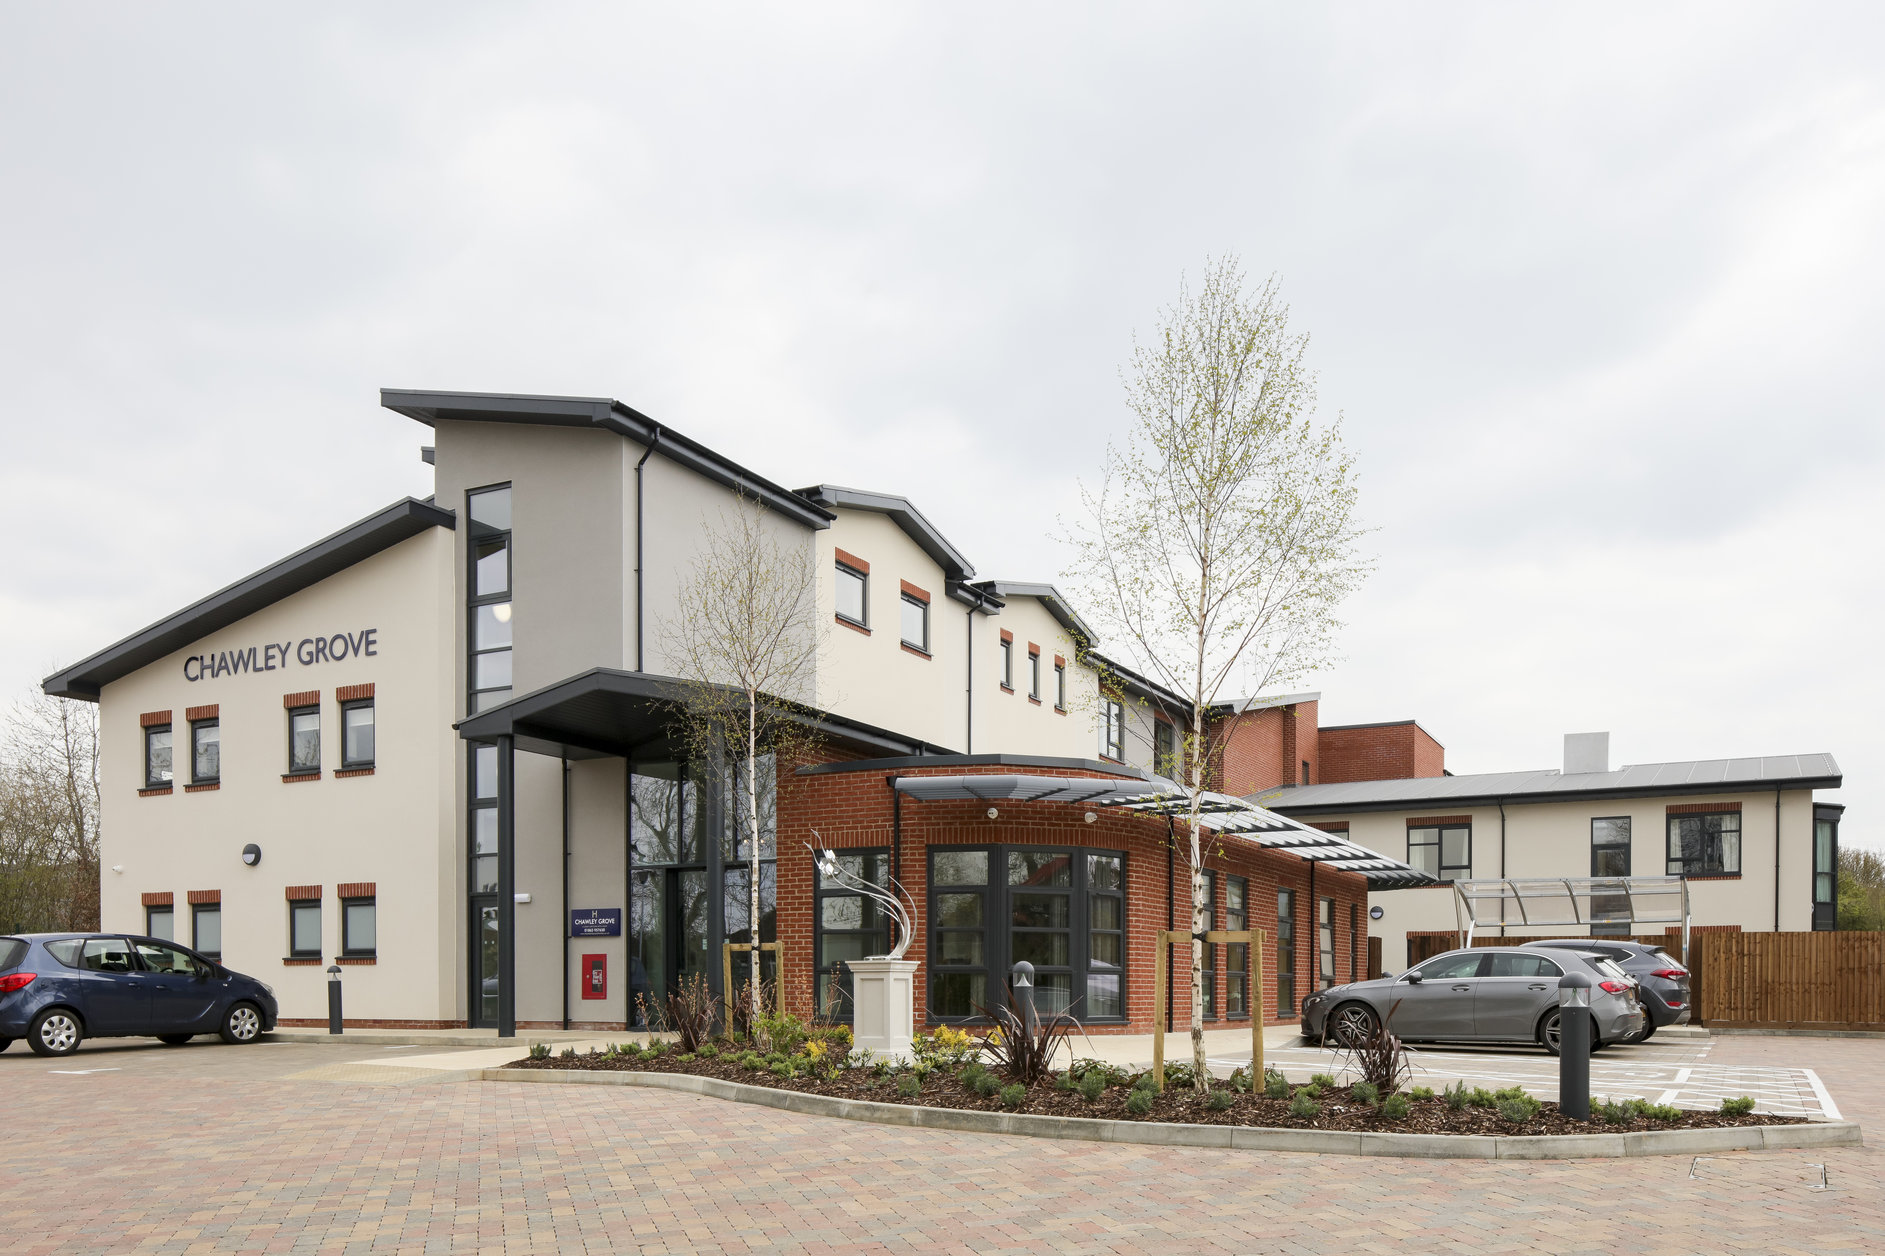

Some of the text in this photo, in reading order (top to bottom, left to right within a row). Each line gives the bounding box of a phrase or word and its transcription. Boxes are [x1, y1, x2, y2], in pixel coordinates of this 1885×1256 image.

[184, 628, 377, 682] CHAWLEY GROVE
[591, 910, 598, 918] H
